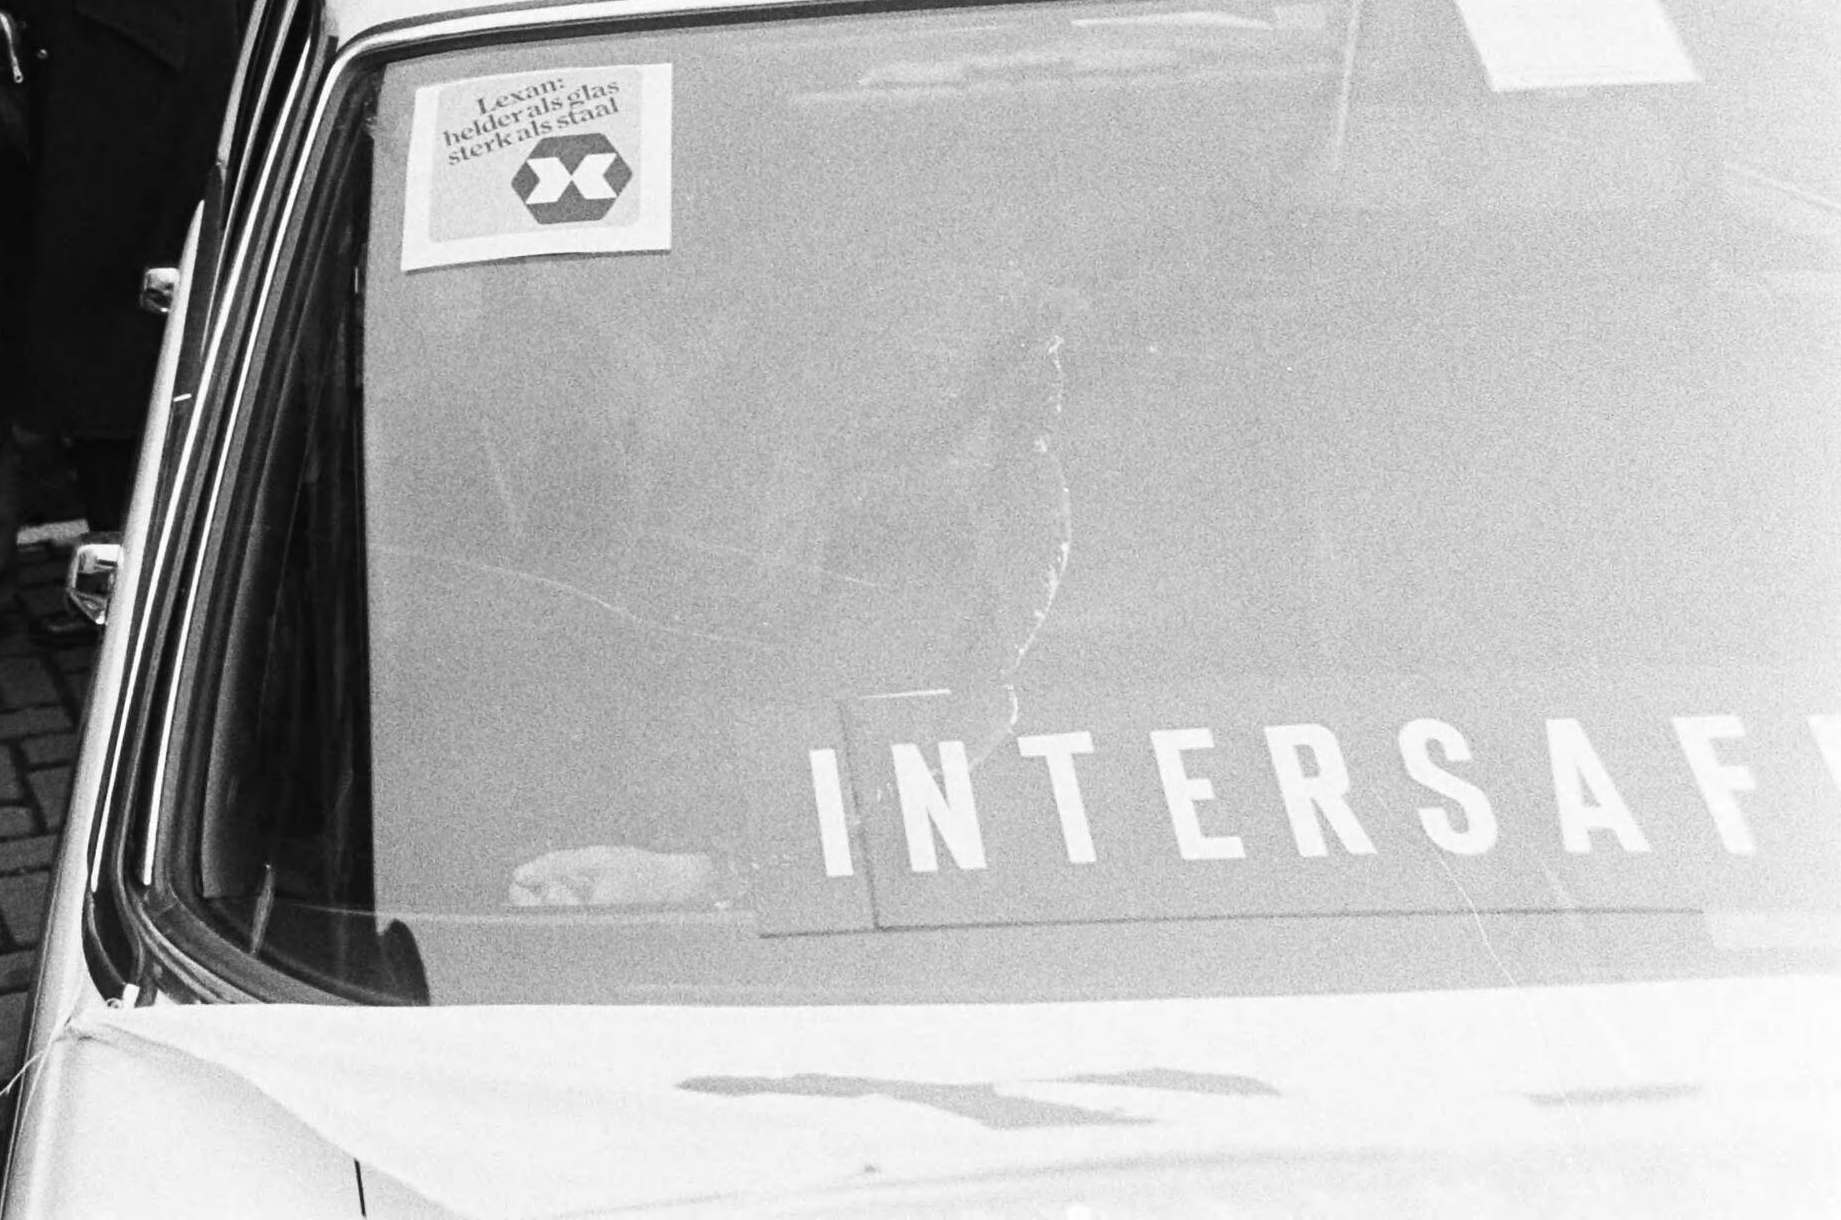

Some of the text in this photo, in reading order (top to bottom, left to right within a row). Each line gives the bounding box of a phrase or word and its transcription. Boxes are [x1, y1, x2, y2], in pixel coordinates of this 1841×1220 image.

[443, 81, 620, 146] helder als glas
[477, 78, 565, 115] Lexan:
[448, 96, 620, 166] sterk als staal
